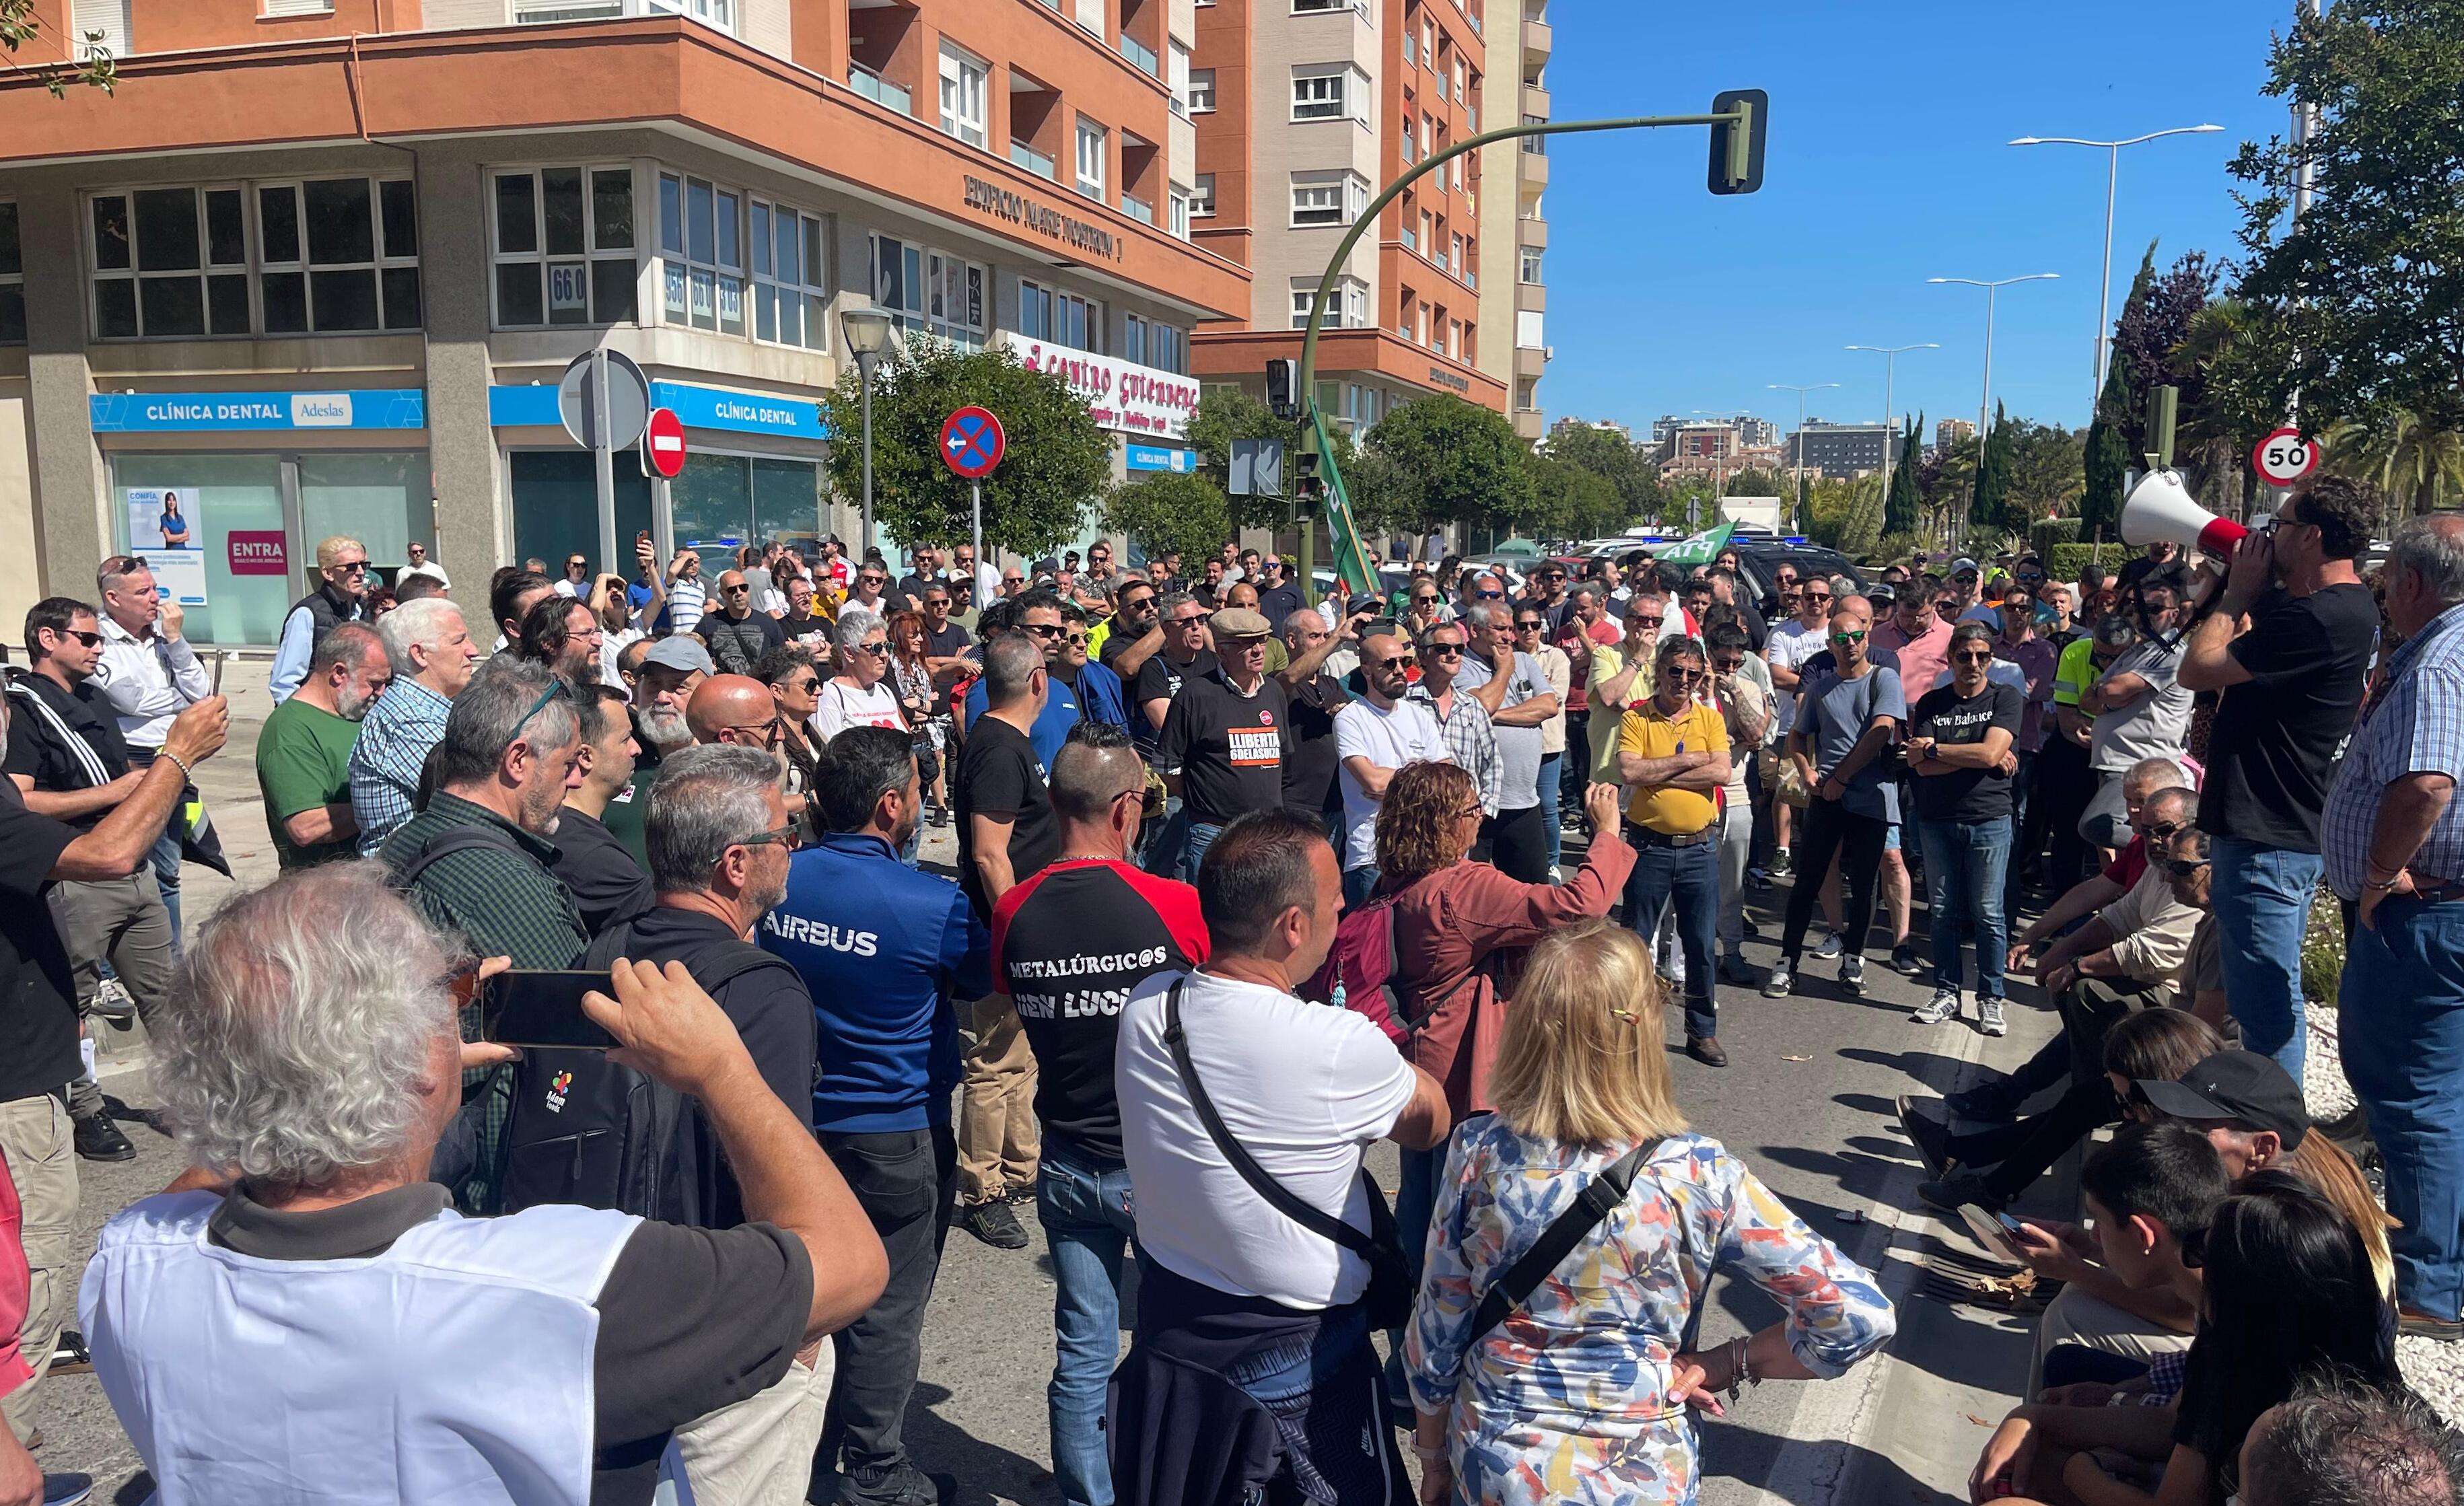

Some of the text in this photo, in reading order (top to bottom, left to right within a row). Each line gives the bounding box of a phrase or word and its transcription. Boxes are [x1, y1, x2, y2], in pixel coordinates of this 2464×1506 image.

[964, 174, 1023, 221] EDIFICIO
[1024, 199, 1061, 235] MARE
[1061, 215, 1113, 254] NOSTRUM
[147, 402, 344, 421] CLÍNICA DENTAL Adeslas
[715, 400, 797, 426] CLÍNICA DENTAL
[2268, 447, 2305, 466] 50
[233, 542, 283, 557] ENTRA
[1955, 711, 1993, 726] Balance
[763, 910, 878, 957] AIRBUS
[1010, 946, 1167, 978] METALÚRGIC@S
[546, 1090, 565, 1106] Adam
[1361, 1426, 1369, 1451] NIKE
